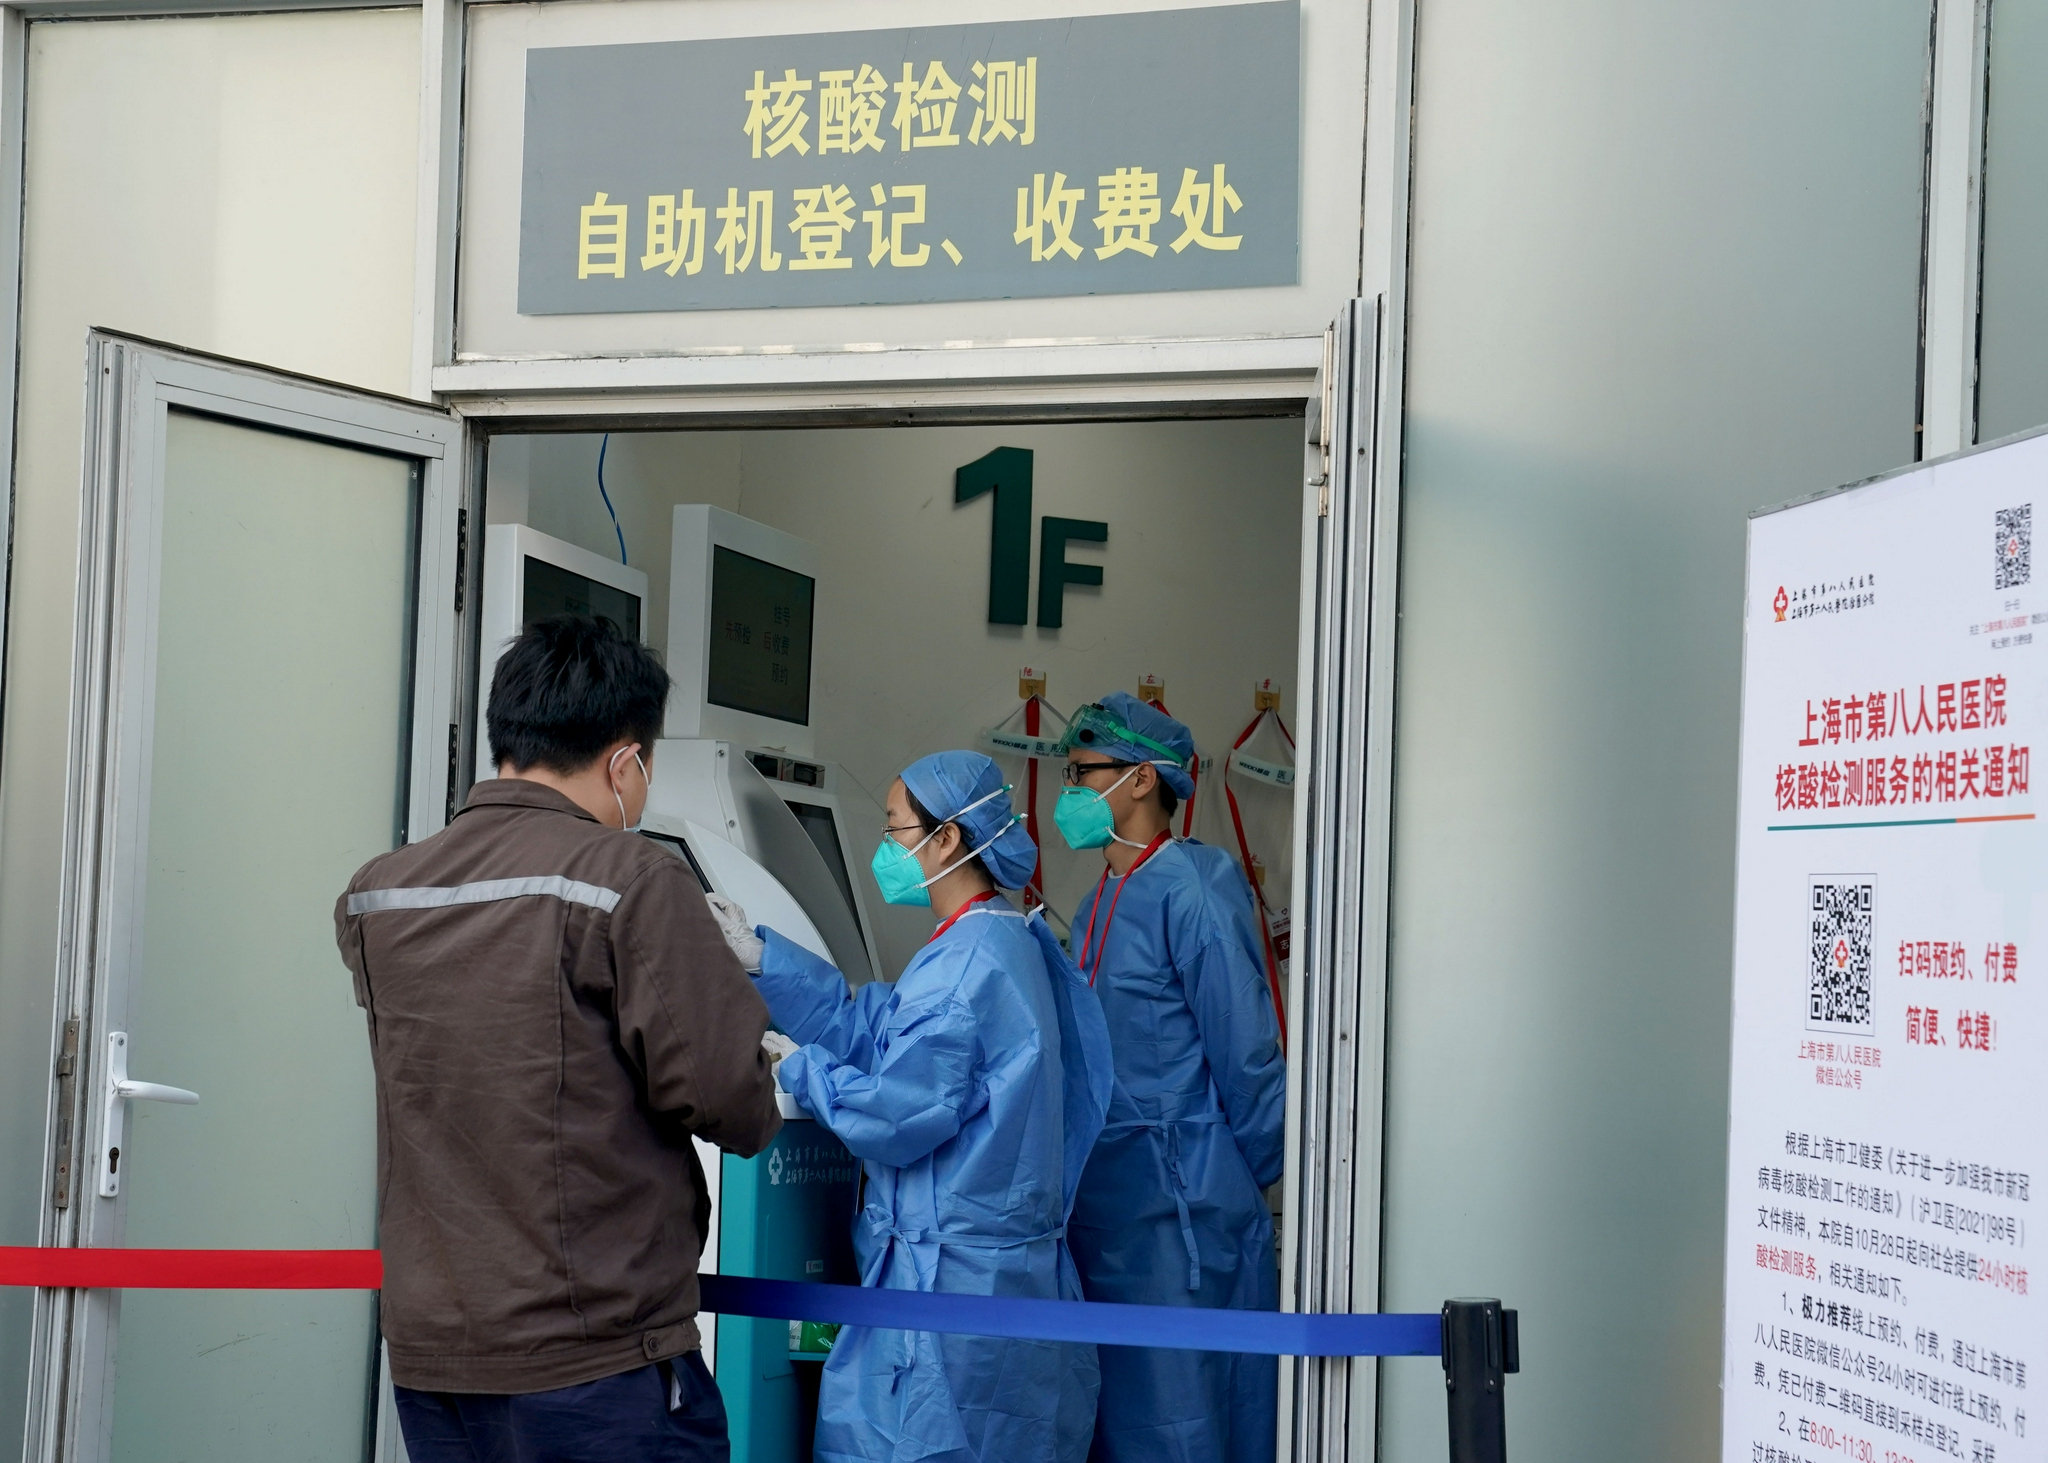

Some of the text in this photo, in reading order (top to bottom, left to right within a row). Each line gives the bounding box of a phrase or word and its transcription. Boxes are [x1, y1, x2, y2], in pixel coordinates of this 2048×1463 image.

[743, 56, 1039, 160] 核酸检测
[577, 163, 1244, 280] 自助机登记、收费处
[955, 445, 1108, 629] 1F
[1798, 673, 2008, 747] 上海市第八人民医院
[1774, 742, 2030, 812] 核酸检测服务的相关通知
[1898, 939, 2018, 983] 扫码预约、付费
[1797, 1039, 1882, 1068] 上海市第八人民医院
[1815, 1065, 1863, 1090] 微信公众号
[1785, 1130, 2030, 1202] 根据上海市卫健委《关于进一步加强我市新冠
[1754, 1322, 2026, 1438] 八人民医院微信公众号24小时可进行线上预约、付
